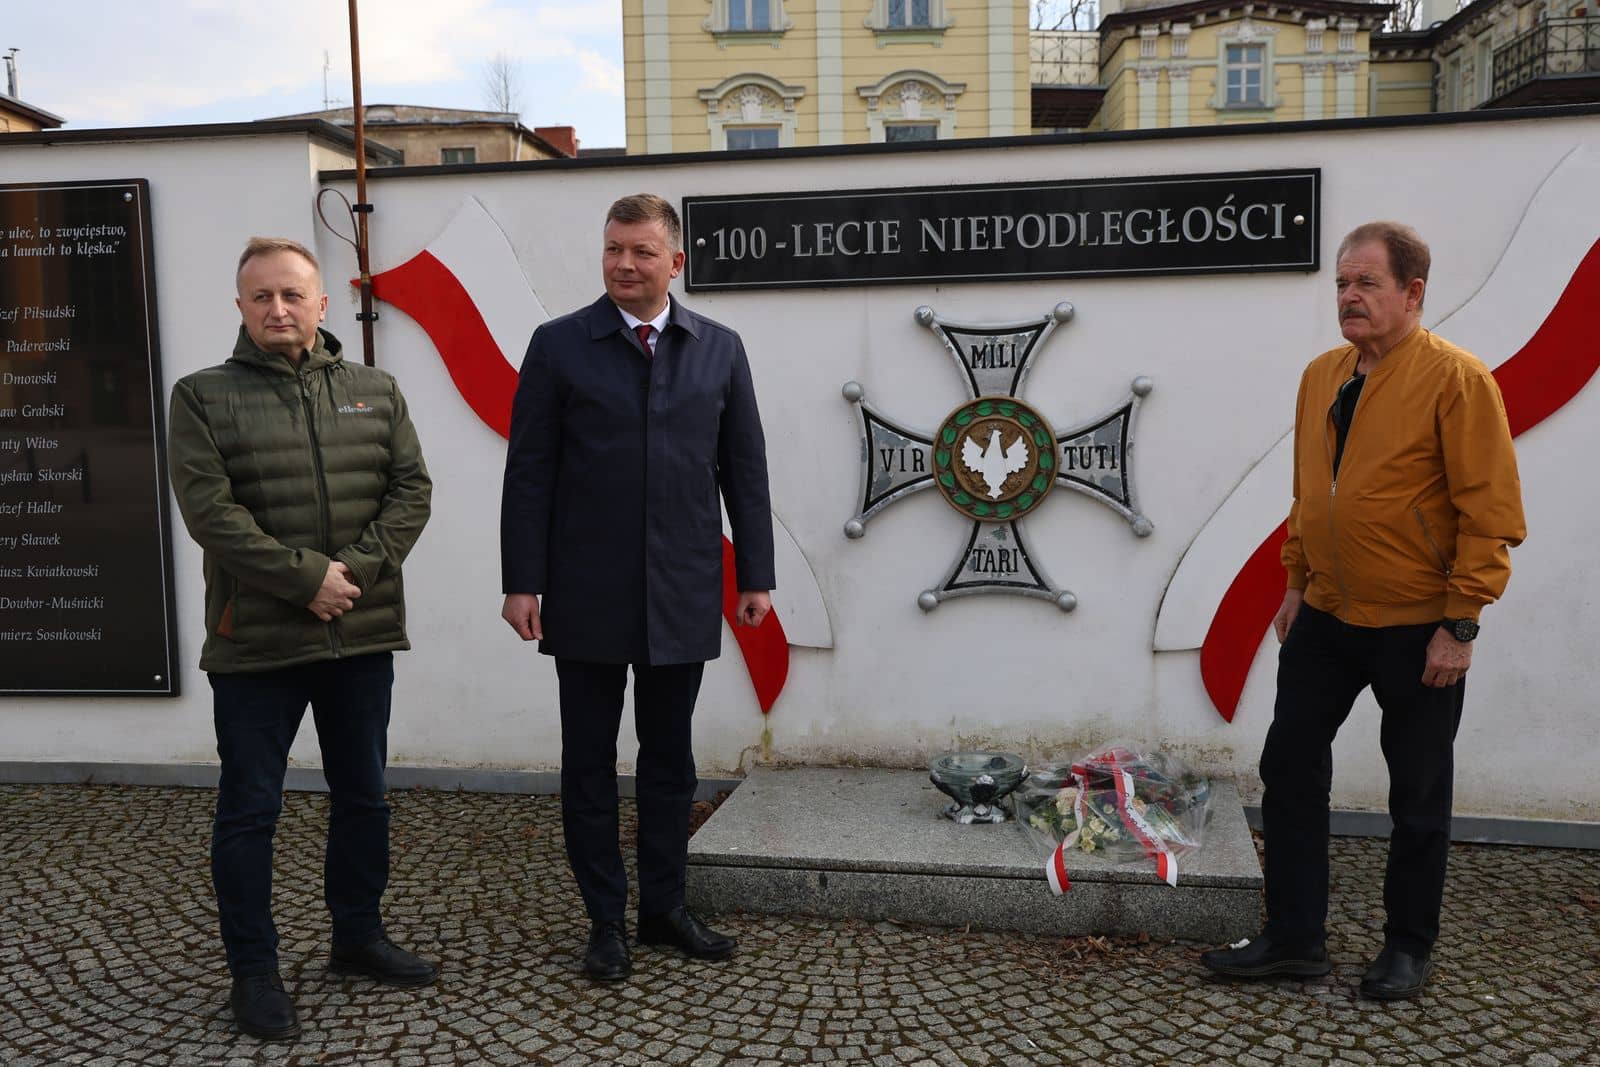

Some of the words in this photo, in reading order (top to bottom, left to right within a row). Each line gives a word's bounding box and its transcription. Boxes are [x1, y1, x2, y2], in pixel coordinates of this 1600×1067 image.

[8, 226, 34, 240] ulec,
[39, 226, 51, 238] to
[55, 223, 127, 240] zwycięstwo,
[712, 226, 767, 261] 100
[918, 193, 1287, 253] NIEPODLEGŁOŚCI
[13, 243, 55, 257] laurach
[60, 243, 72, 256] to
[6, 338, 71, 353] Paderewski
[970, 342, 1018, 370] MILI
[3, 371, 57, 385] Dmowski
[21, 403, 65, 418] Grabski
[25, 436, 59, 449] Witos
[879, 447, 926, 473] VIR
[1063, 445, 1119, 471] TUTI
[38, 468, 83, 482] Sikorski
[27, 500, 64, 514] Haller
[21, 532, 61, 546] Sławek
[971, 547, 1019, 573] TARI
[27, 564, 100, 578] Kwiatkowski
[0, 596, 105, 609] Dowbor-Muśnicki
[36, 627, 102, 641] Sosnkowski
